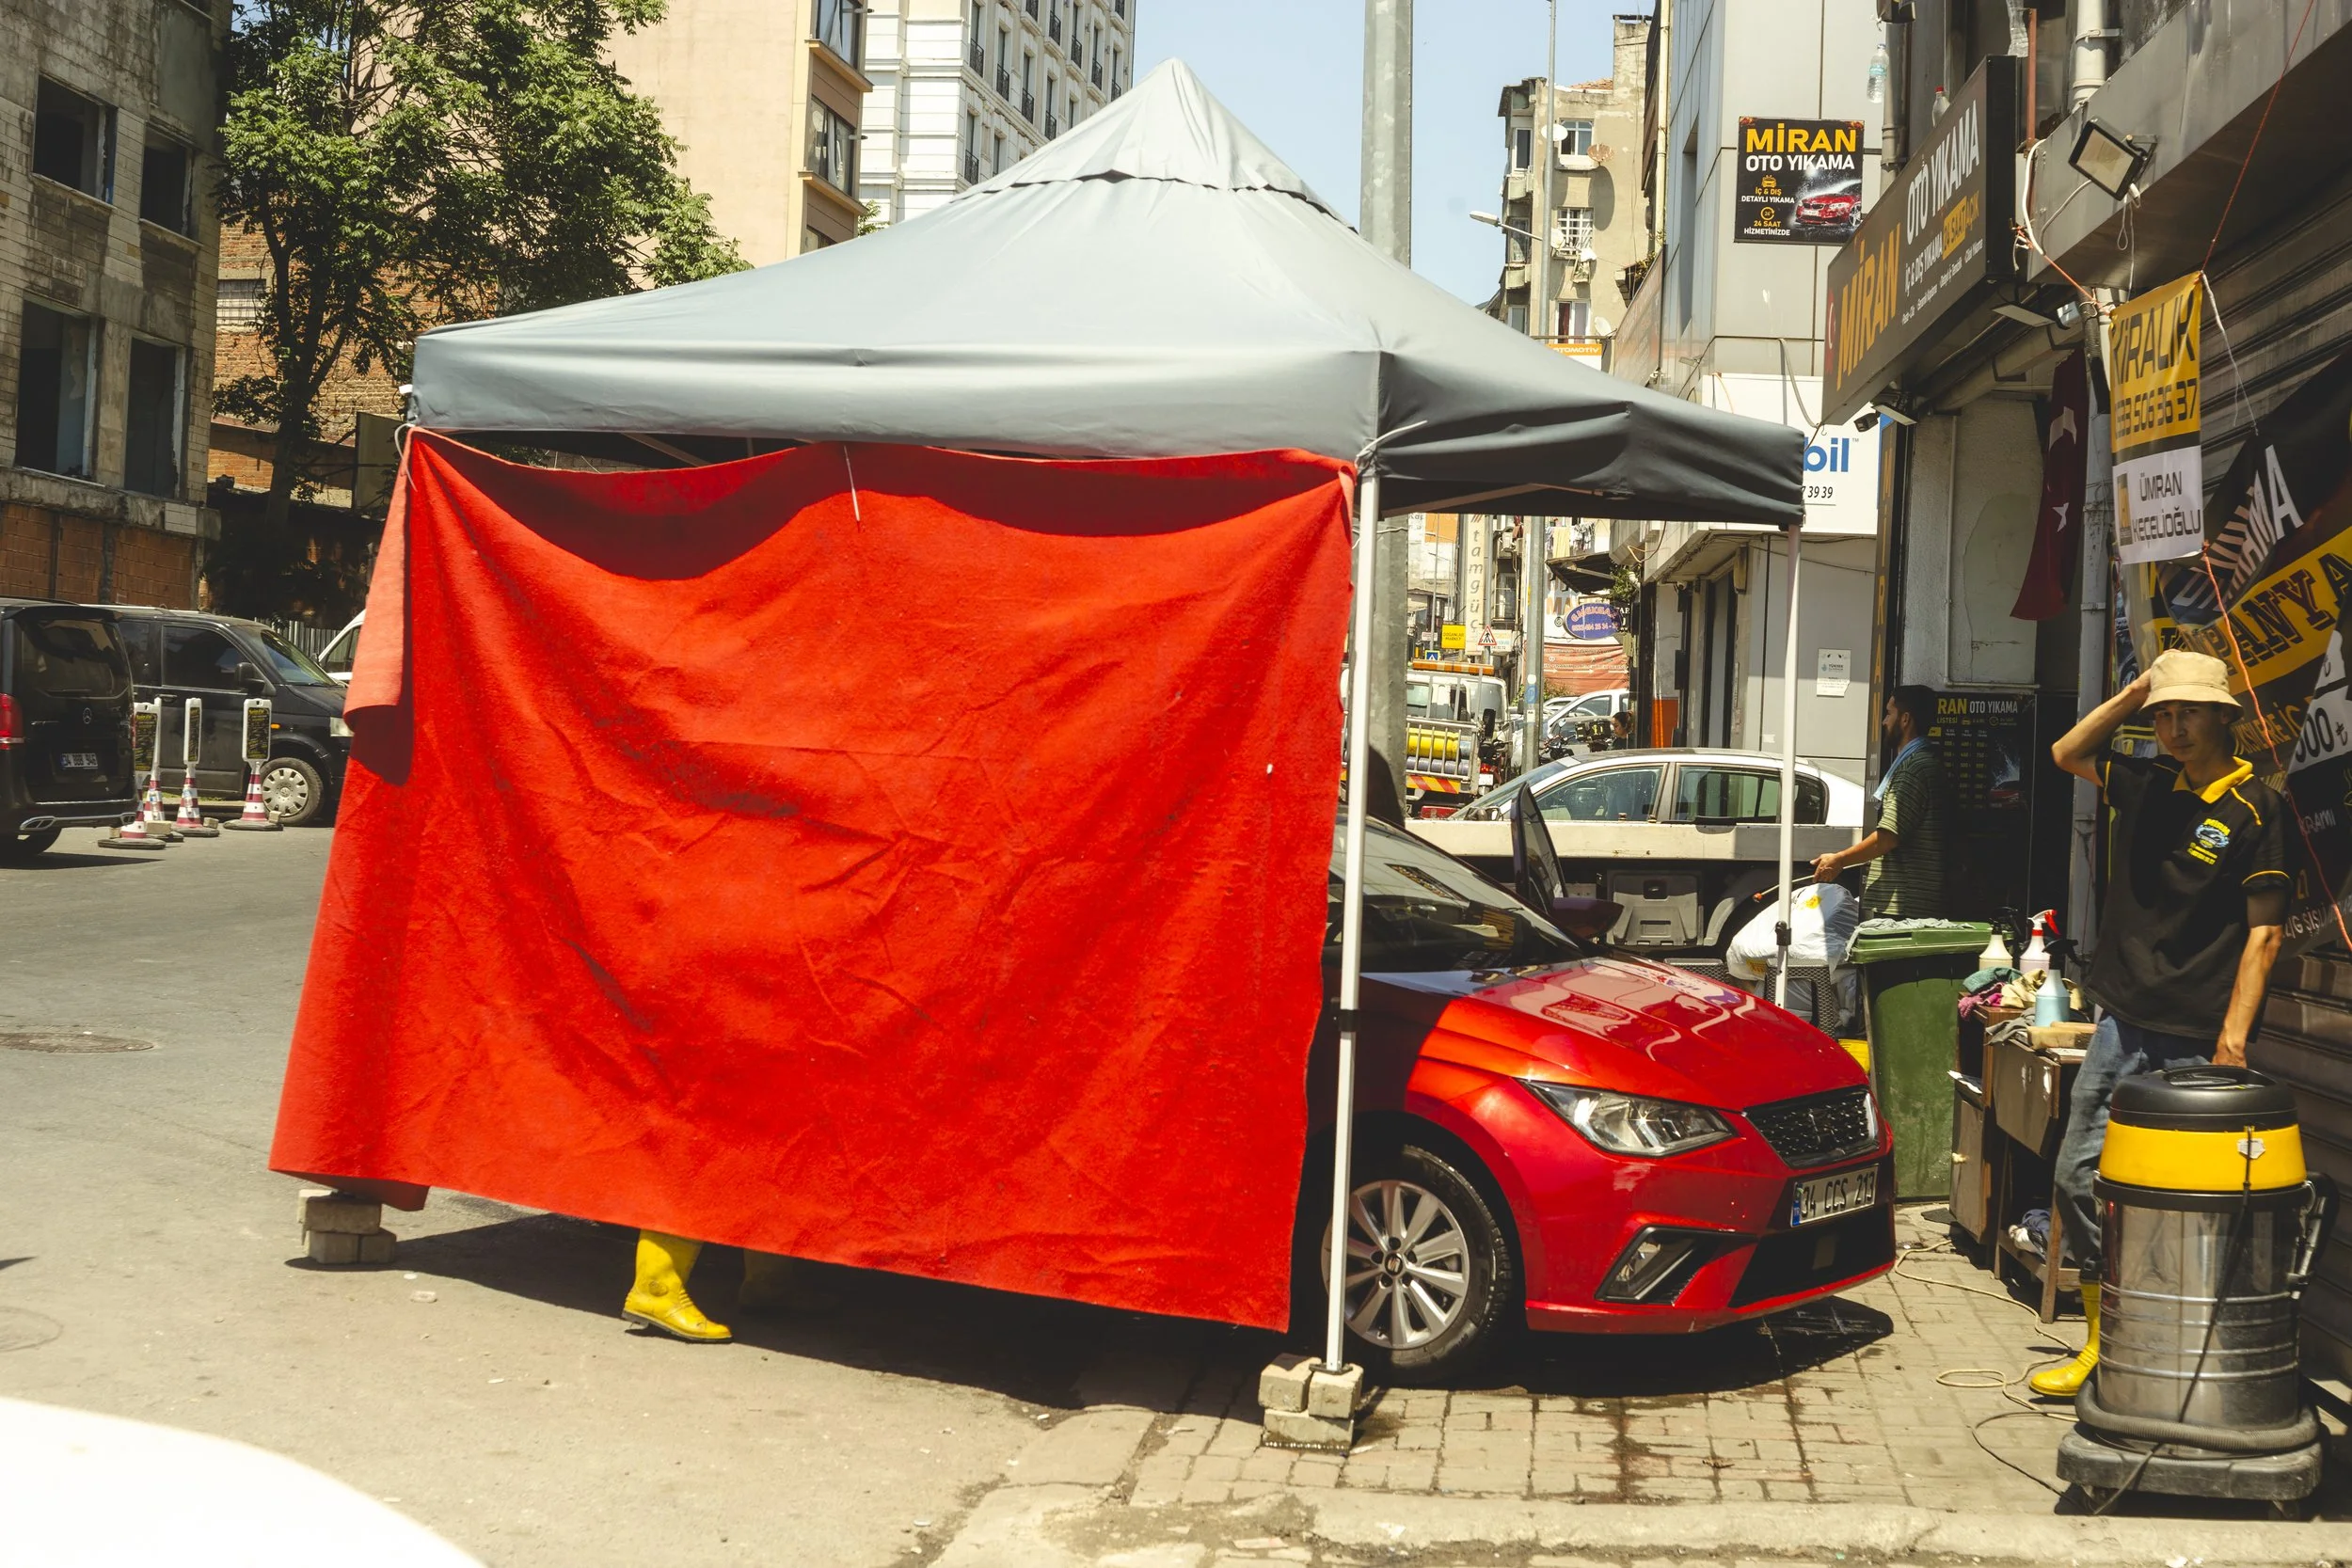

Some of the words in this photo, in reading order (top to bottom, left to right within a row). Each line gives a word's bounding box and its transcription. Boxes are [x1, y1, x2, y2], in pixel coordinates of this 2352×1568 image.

[1746, 122, 1856, 152] MİRAN
[1745, 154, 1783, 171] OTO
[1787, 154, 1855, 170] YIKAMA
[1906, 163, 1929, 245] OTO
[1931, 99, 1980, 217] YIKAMA
[1741, 195, 1769, 203] DETAYLI
[1770, 196, 1795, 204] YIKAMA
[1755, 187, 1762, 196] İÇ
[1770, 188, 1782, 197] DIŞ
[1743, 226, 1791, 236] HİZMETİNİZDE
[1836, 221, 1901, 392] MİRAN
[2176, 377, 2198, 421] 37
[1804, 436, 1850, 473] bil
[1807, 485, 1820, 499] 39
[1820, 485, 1834, 499] 39
[2139, 470, 2183, 502] ÜMRAN
[2132, 505, 2201, 549] KEÇELİOĞLU
[1871, 447, 1892, 742] MİRAN
[1937, 698, 1967, 715] RAN
[1969, 701, 1986, 714] OTO
[1987, 700, 2018, 714] YIKAMA
[1801, 1184, 1817, 1218] 34
